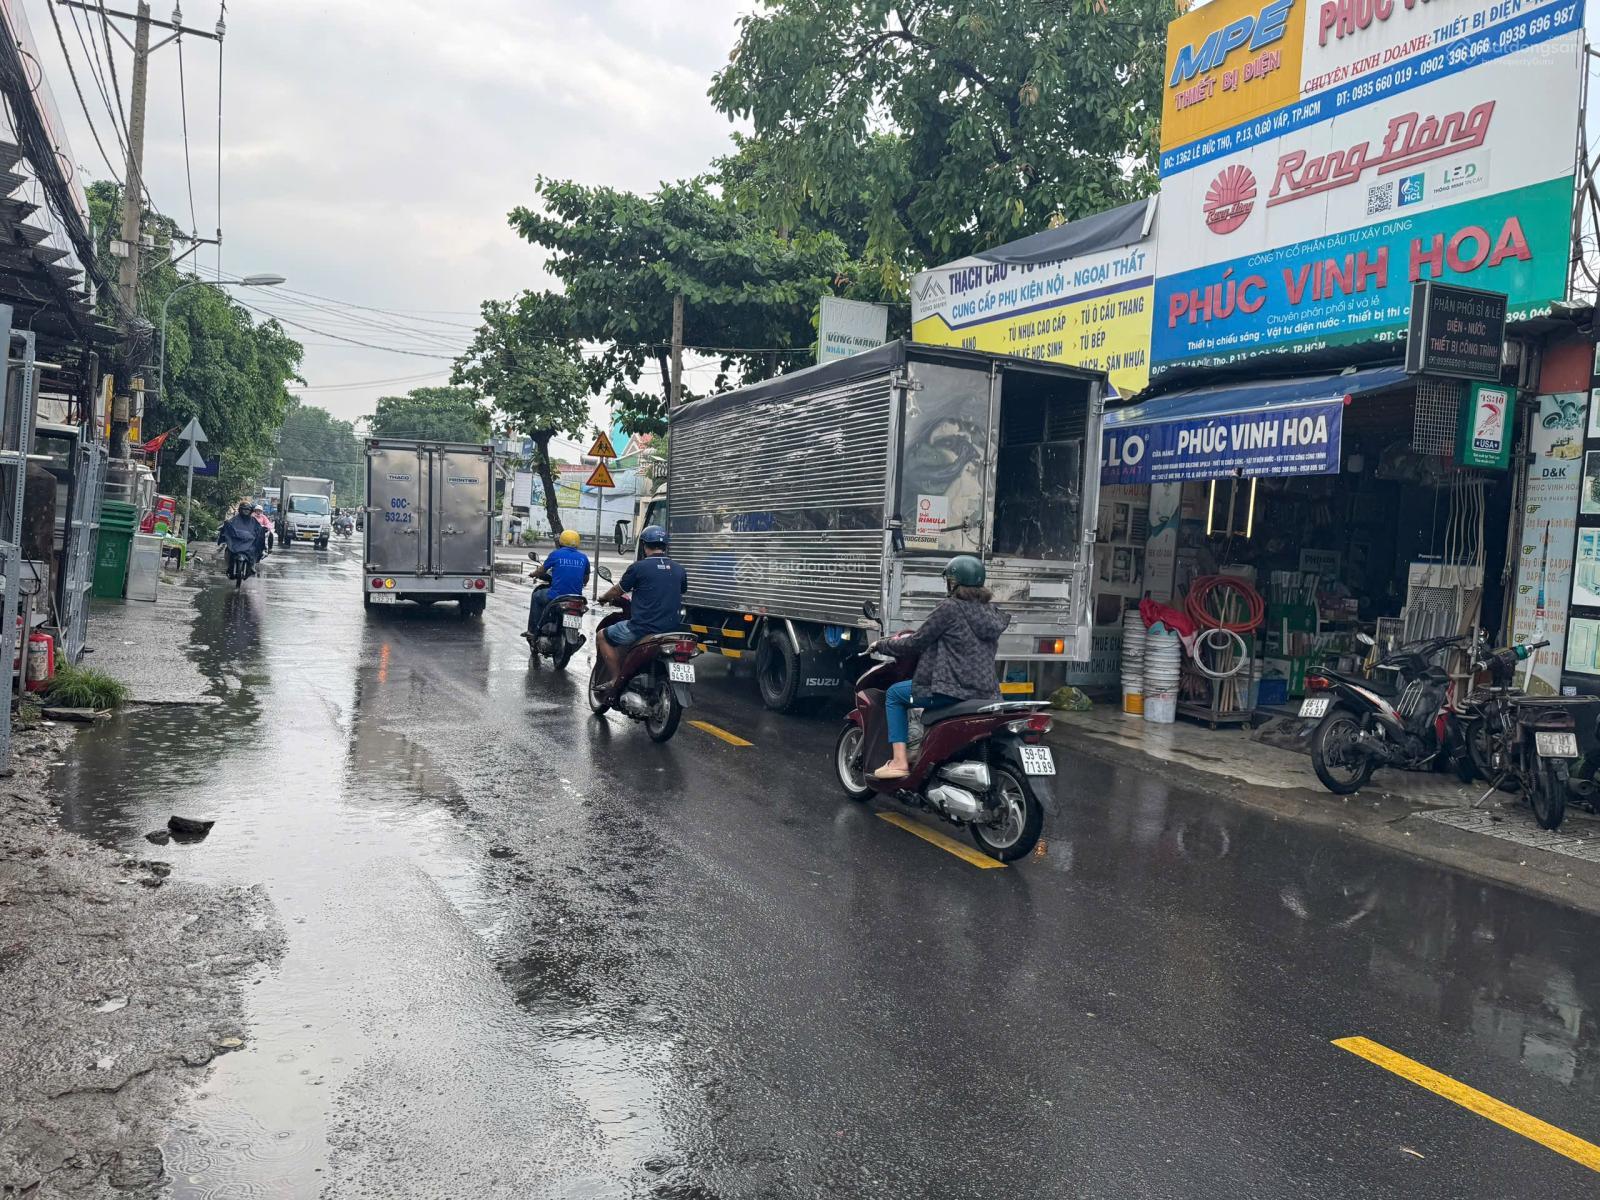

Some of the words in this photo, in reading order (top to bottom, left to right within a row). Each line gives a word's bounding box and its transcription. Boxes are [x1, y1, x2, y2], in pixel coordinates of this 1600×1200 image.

[1433, 13, 1469, 44] THIẾT
[1473, 11, 1485, 29] BỊ
[1490, 0, 1521, 22] ĐIỆN
[1169, 0, 1294, 88] MPE
[1337, 90, 1350, 107] ĐT:
[1352, 81, 1374, 101] 0935
[1376, 73, 1392, 92] 660
[1394, 66, 1412, 85] 019
[1420, 55, 1444, 76] 0902
[1448, 46, 1467, 65] 396
[1470, 38, 1489, 58] 066
[1499, 23, 1526, 47] 0938
[1529, 14, 1551, 36] 696
[1553, 4, 1576, 27] 987
[1175, 76, 1216, 111] THIẾT
[1222, 70, 1239, 92] BỊ
[1243, 50, 1281, 82] ĐIỆN
[1304, 64, 1350, 94] CHUYÊN
[1351, 53, 1381, 77] KINH
[1164, 157, 1175, 169] ĐC:
[1176, 150, 1191, 165] 1362
[1192, 146, 1201, 160] LÊ
[1202, 138, 1216, 156] ĐỨC
[1292, 101, 1321, 123] TP.HCM
[1404, 192, 1421, 203] HCL
[1248, 254, 1274, 268] CÔNG
[1274, 252, 1285, 262] TY
[1348, 232, 1360, 243] TƯ
[1361, 226, 1381, 240] XÂY
[1382, 219, 1413, 238] DỰNG
[948, 266, 983, 297] THẠCH
[952, 300, 976, 320] CUNG
[978, 289, 996, 314] CẤP
[998, 289, 1017, 308] PHỤ
[1020, 279, 1043, 303] KIỆN
[1046, 273, 1064, 295] NỘI
[1074, 262, 1109, 287] NGOẠI
[1114, 247, 1146, 274] THẤT
[1168, 268, 1268, 329] PHÚC
[1282, 245, 1390, 306] VINH
[1408, 216, 1533, 283] HOA
[1081, 305, 1090, 326] TỦ
[1118, 296, 1145, 317] THANG
[1267, 311, 1300, 325] Chuyên
[1300, 306, 1324, 321] phân
[1325, 300, 1346, 315] phối
[1356, 297, 1369, 309] và
[1505, 310, 1526, 323] 396
[1008, 323, 1017, 342] TỦ
[1018, 320, 1035, 341] NHỰA
[1037, 318, 1050, 336] CAO
[1052, 310, 1066, 332] CẤP
[1080, 330, 1089, 351] TỦ
[1091, 326, 1106, 349] BẾP
[1187, 338, 1206, 350] Thiết
[1207, 339, 1215, 349] bị
[1216, 332, 1238, 346] chiếu
[1239, 331, 1260, 342] sáng
[1266, 326, 1281, 339] Vật
[1283, 325, 1293, 334] tư
[1294, 321, 1314, 334] điện
[1316, 316, 1340, 329] nước
[1347, 308, 1372, 324] Thiết
[1374, 308, 1384, 322] bị
[1387, 305, 1401, 318] thi
[1447, 318, 1463, 335] ĐIỆN
[1468, 320, 1486, 336] NƯỚC
[1047, 341, 1063, 358] SINH
[1123, 349, 1145, 371] NHỰA
[1430, 335, 1450, 351] THIẾT
[1451, 340, 1458, 355] BỊ
[1459, 339, 1478, 354] CÔNG
[1480, 341, 1498, 357] TRÌNH
[1177, 420, 1227, 455] PHÚC
[1231, 419, 1279, 453] VINH
[1282, 415, 1328, 447] HOA
[1480, 440, 1494, 448] USA
[1542, 467, 1566, 478] D&K
[385, 511, 412, 523] 532.21
[391, 498, 410, 508] 60C-
[673, 663, 690, 674] 59-L2
[805, 677, 840, 687] ISUZU
[1025, 748, 1047, 760] 59-G2
